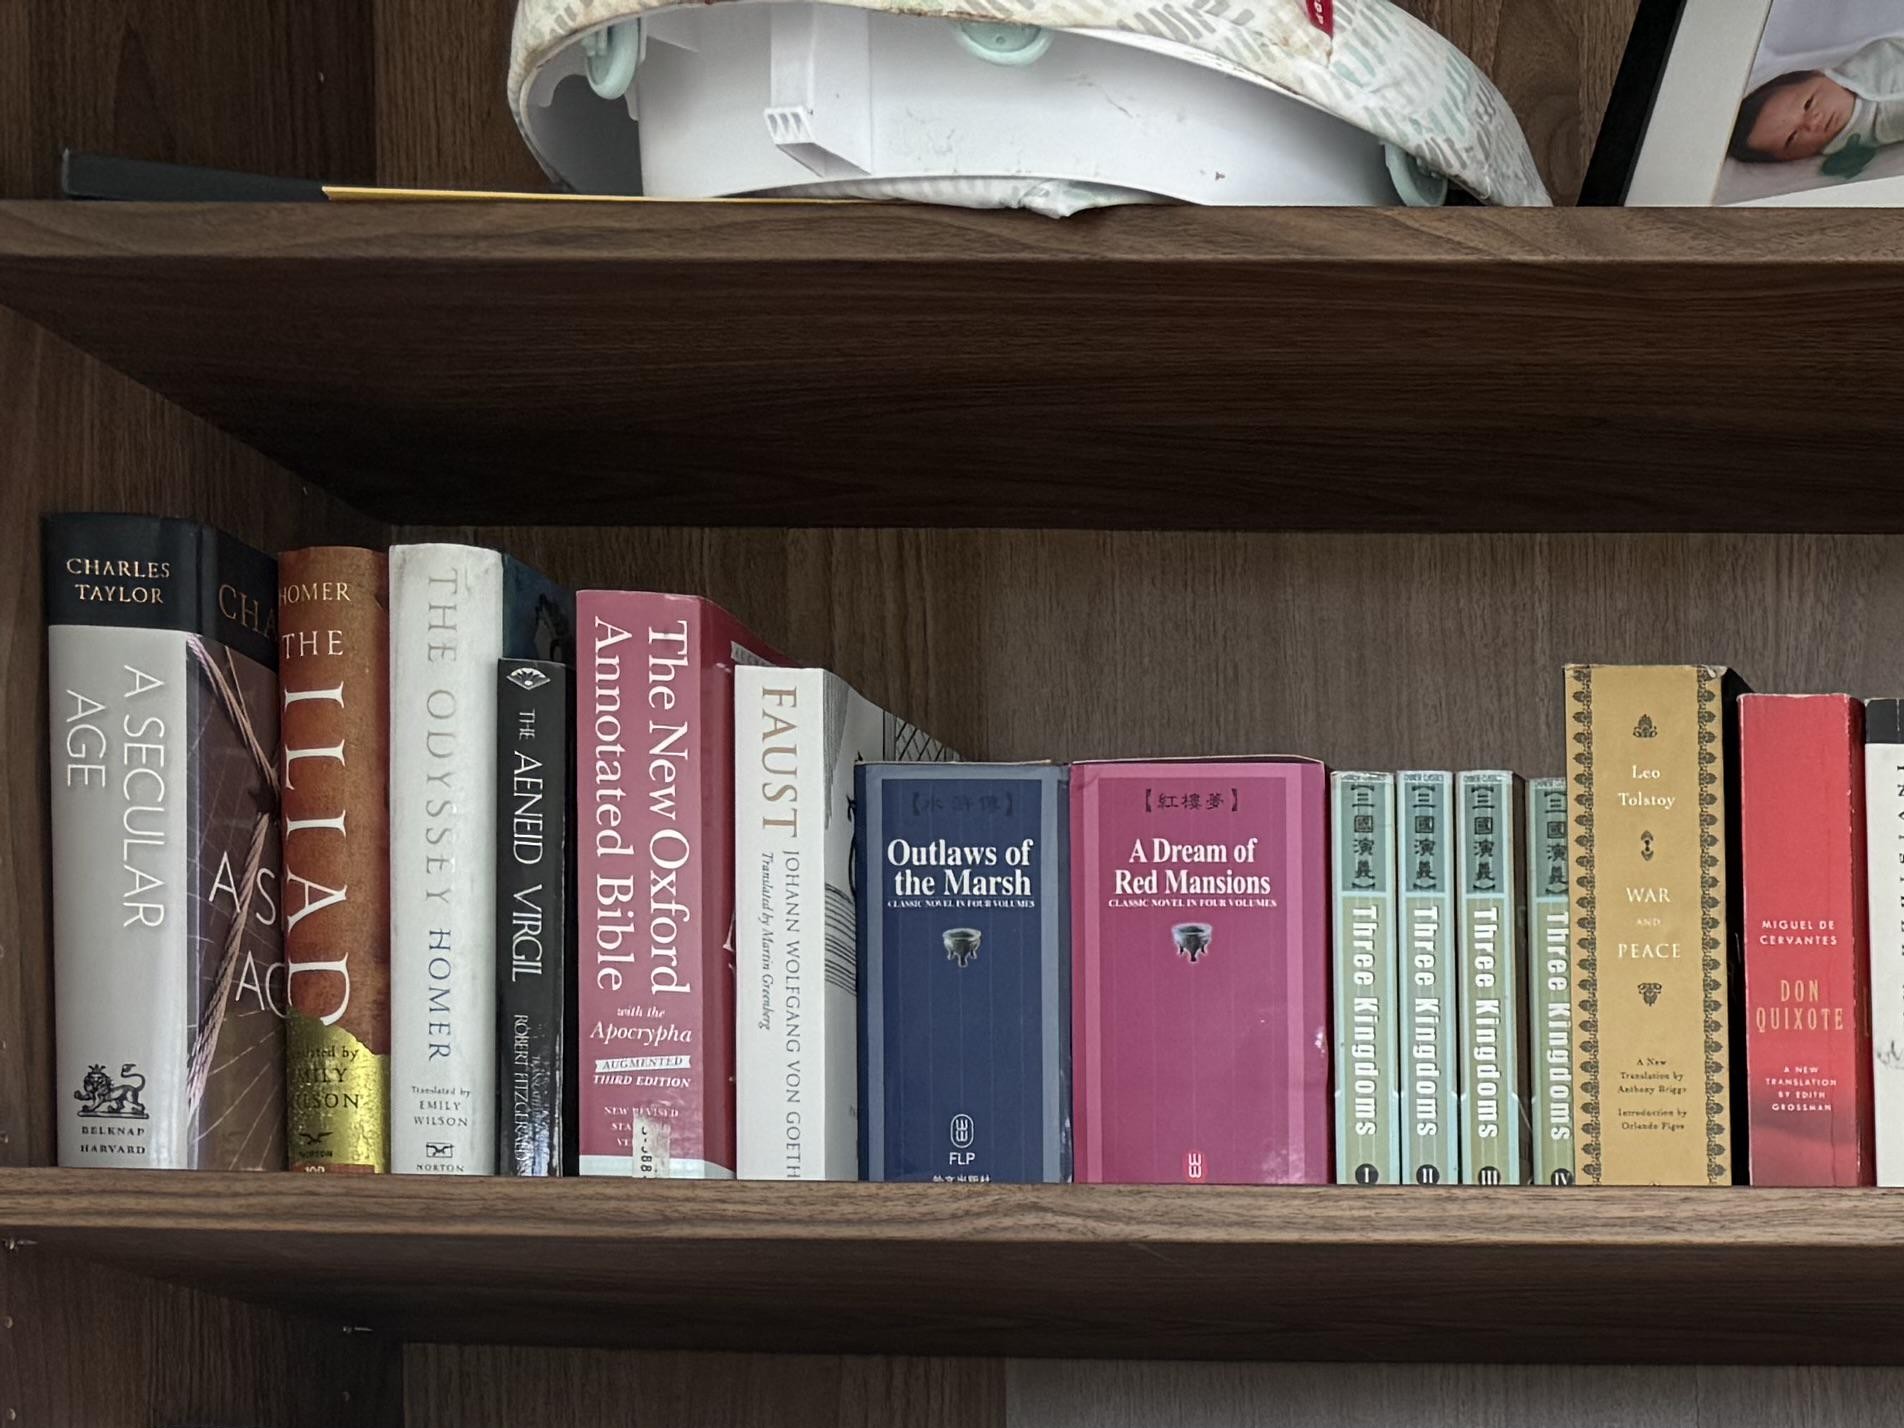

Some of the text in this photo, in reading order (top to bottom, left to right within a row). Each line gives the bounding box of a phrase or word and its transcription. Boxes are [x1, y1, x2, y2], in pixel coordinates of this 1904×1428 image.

[65, 557, 172, 581] CHARLES
[74, 583, 165, 606] TAYLOR
[761, 685, 800, 834] FAUST
[1631, 765, 1662, 779] Leo
[594, 615, 635, 991] Annotated Bible
[647, 619, 691, 995] The New Oxford
[1617, 792, 1676, 810] Tolstoy
[886, 838, 1034, 869] Outlaws of
[1128, 838, 1257, 862] A Dream of
[894, 868, 1031, 897] the Marsh
[1113, 868, 1271, 894] Red Mansions
[1625, 886, 1671, 905] WAR
[1617, 941, 1682, 960] PEACE
[1779, 978, 1821, 1003] DON
[1756, 1005, 1845, 1034] QUIXOTE
[590, 1021, 693, 1048] Apocrypha
[419, 1099, 462, 1113] EMILY
[413, 1115, 468, 1130] WILSON
